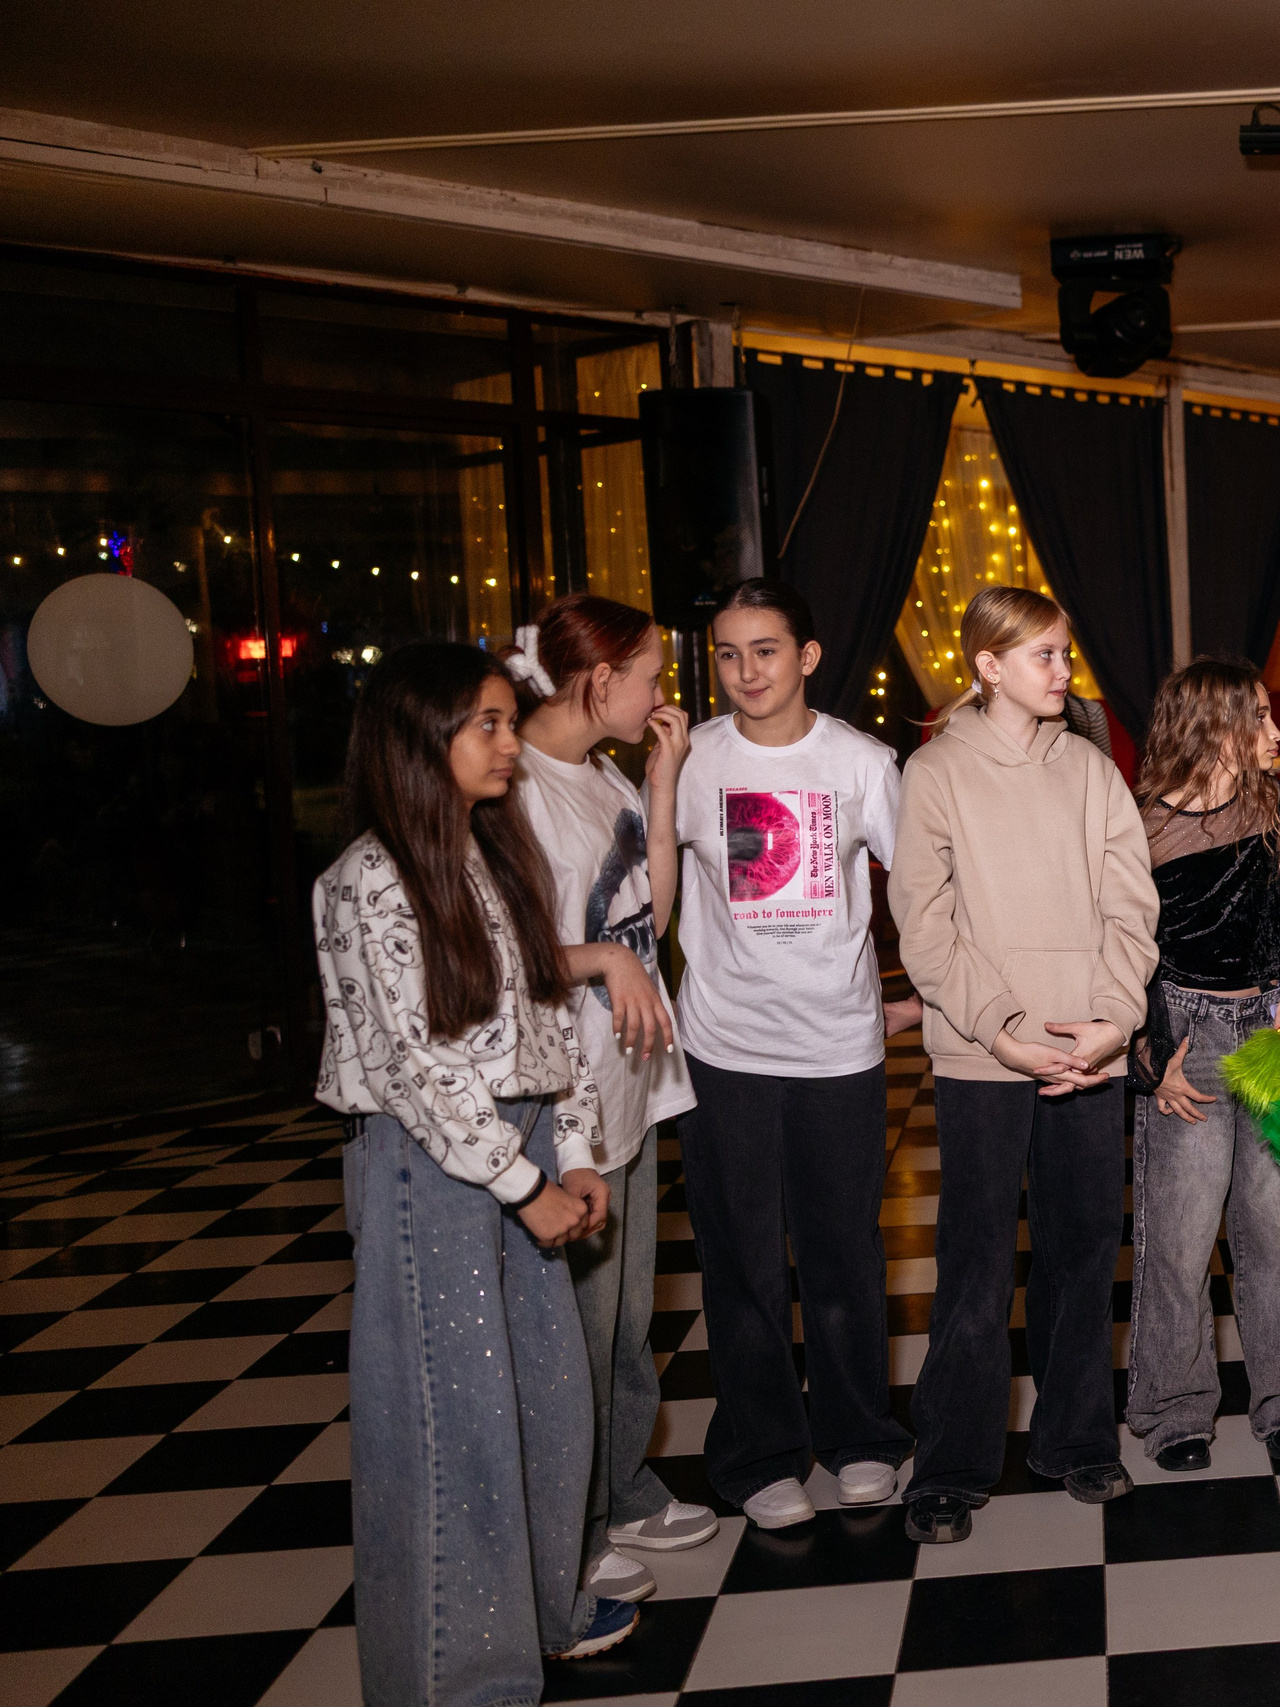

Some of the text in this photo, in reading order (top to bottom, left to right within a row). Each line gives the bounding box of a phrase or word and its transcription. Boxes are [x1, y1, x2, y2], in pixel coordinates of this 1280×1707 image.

[1114, 249, 1145, 260] WEN
[809, 811, 817, 832] Times
[810, 832, 819, 849] York
[822, 794, 834, 898] MEN WALK ON MOON
[810, 850, 818, 865] New
[810, 865, 819, 878] The
[733, 910, 759, 920] road
[762, 909, 772, 919] to
